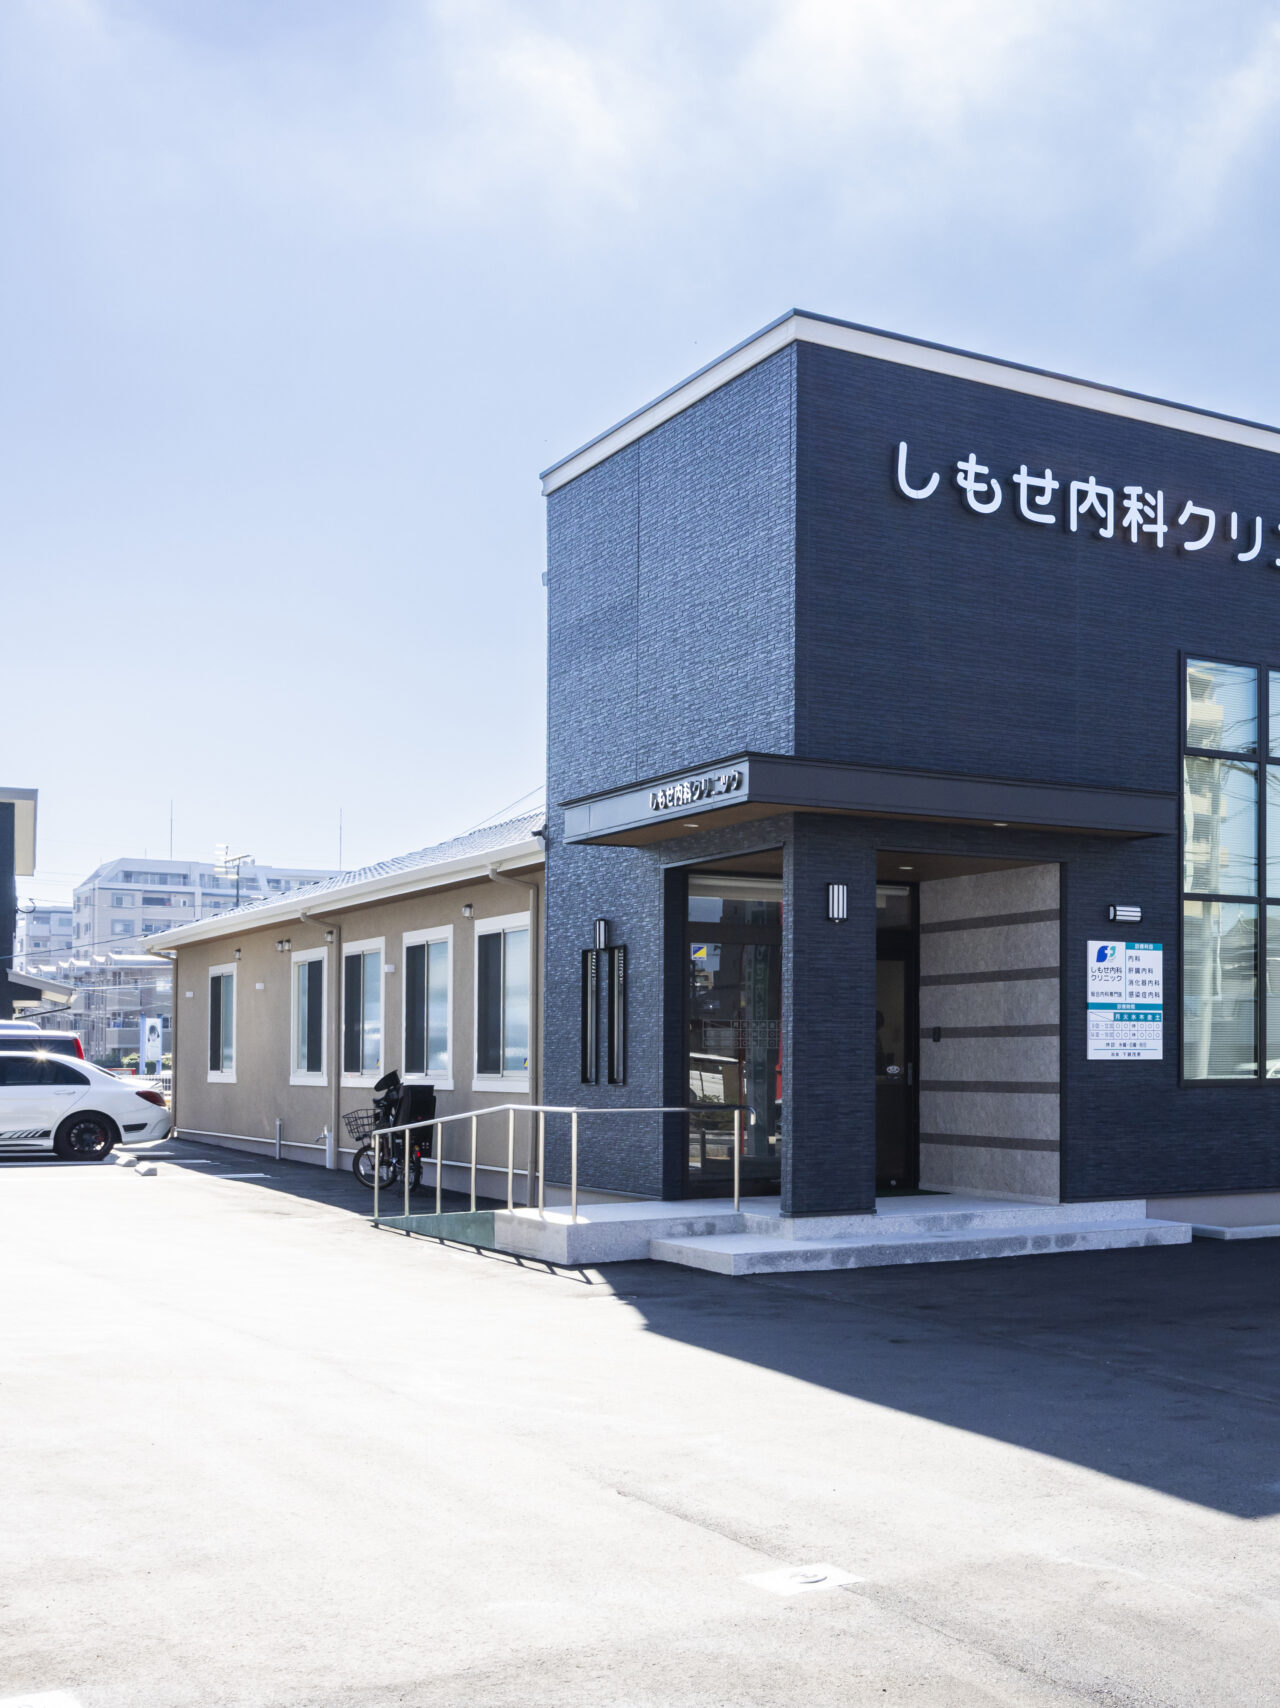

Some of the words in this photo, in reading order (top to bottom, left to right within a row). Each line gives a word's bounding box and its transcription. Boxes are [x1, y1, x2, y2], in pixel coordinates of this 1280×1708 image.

[649, 769, 743, 811] しもせ内科クリニック
[1090, 966, 1123, 974] しもせ内科
[1128, 967, 1154, 975] 肝臓内科
[1090, 974, 1123, 982] クリニック
[1128, 979, 1160, 987] 消化器内科
